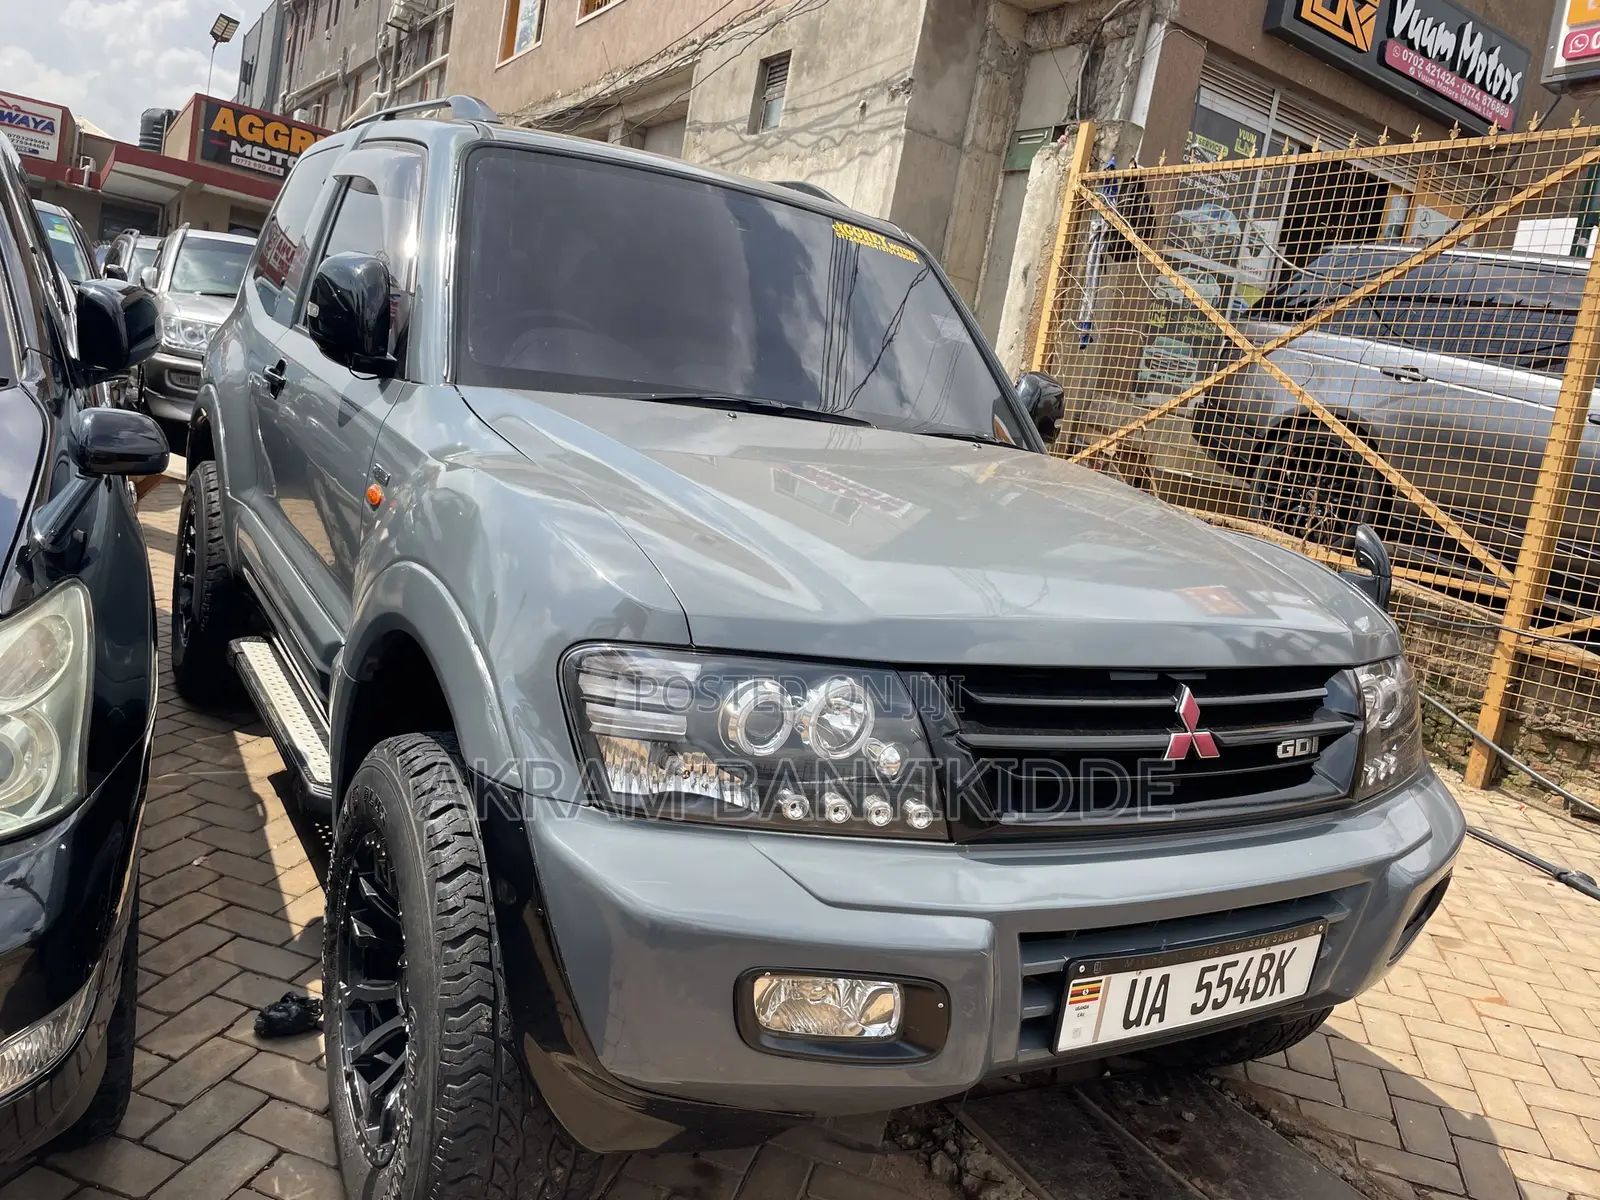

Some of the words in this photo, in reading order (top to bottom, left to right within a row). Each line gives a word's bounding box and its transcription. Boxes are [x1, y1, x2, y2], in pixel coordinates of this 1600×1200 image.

[1393, 0, 1456, 61] Vuum
[1456, 21, 1522, 104] Motors
[1401, 49, 1424, 70] 0702
[1425, 62, 1456, 86] 421424
[1461, 84, 1480, 101] 0774
[1481, 96, 1510, 118] 876869
[1417, 69, 1436, 86] Vuum
[1436, 80, 1459, 99] Motors
[1459, 93, 1482, 112] Uganda
[210, 107, 324, 153] AGGR
[235, 157, 252, 167] 0772
[1277, 736, 1319, 758] GDI
[1272, 931, 1298, 944] Space
[1122, 973, 1171, 1030] UA
[1190, 946, 1297, 1015] 554BK
